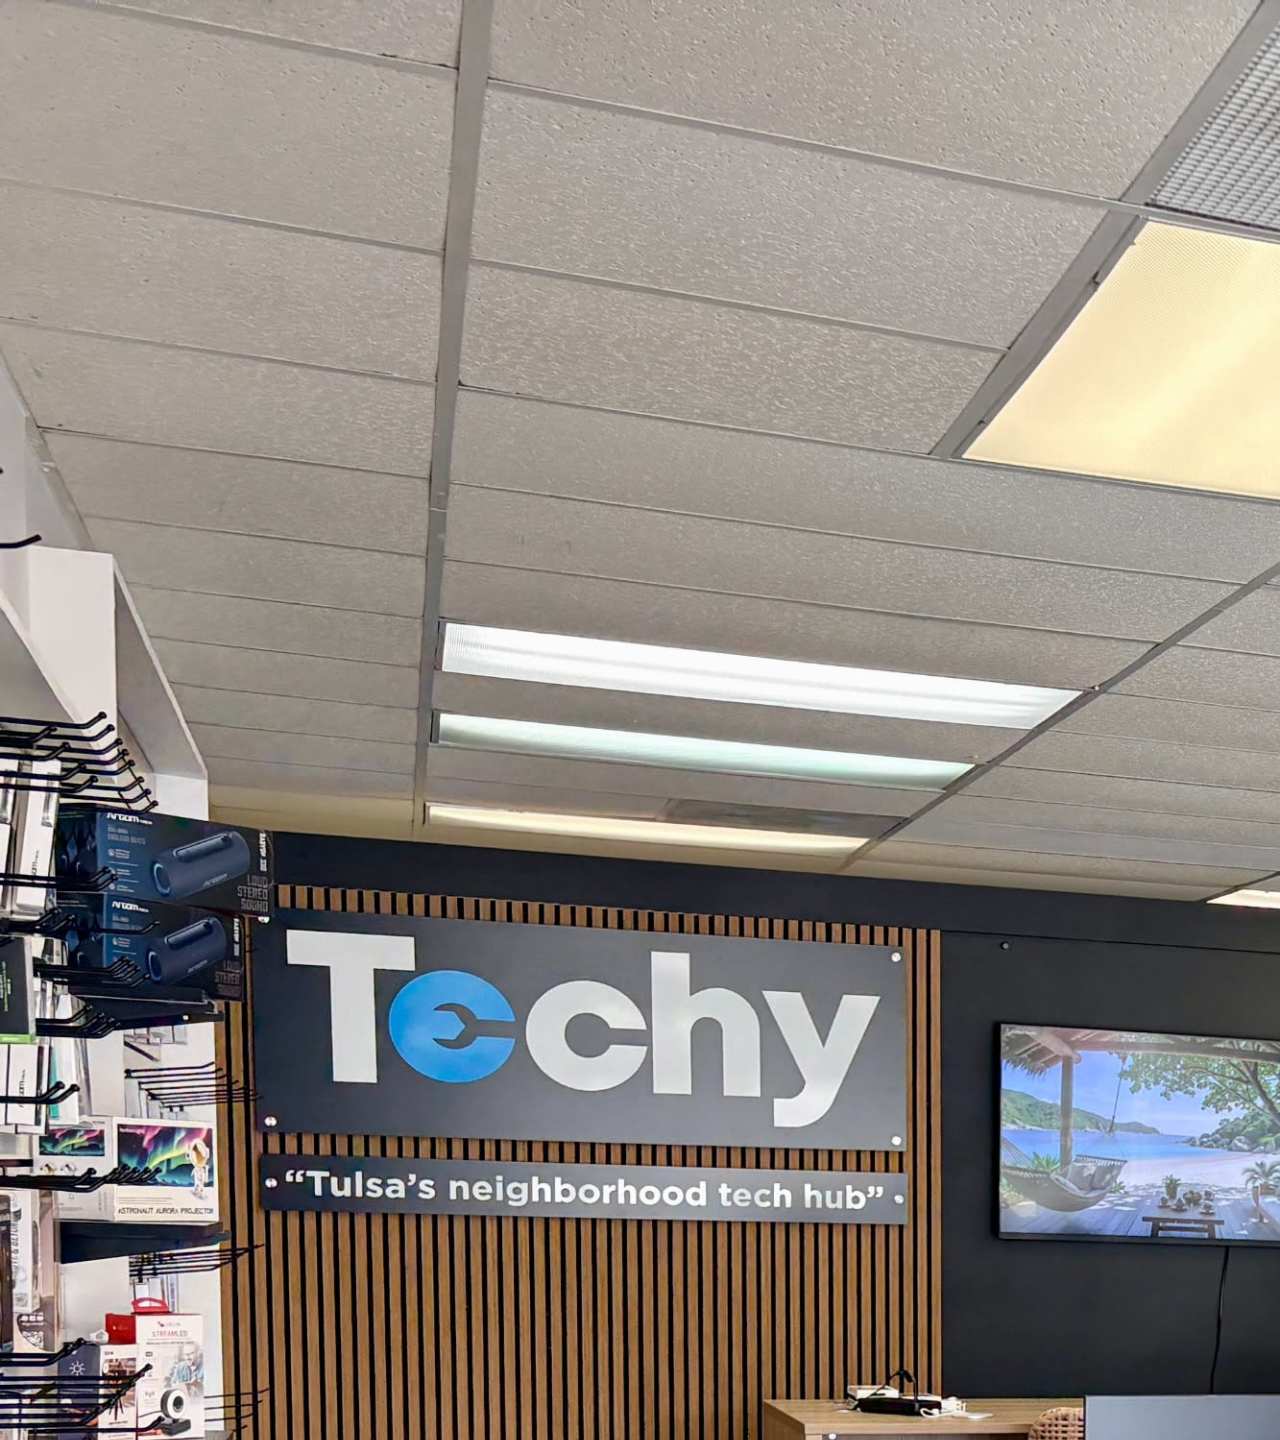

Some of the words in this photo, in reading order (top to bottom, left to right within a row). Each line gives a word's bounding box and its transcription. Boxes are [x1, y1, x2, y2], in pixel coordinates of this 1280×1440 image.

[237, 886, 268, 900] STEREO
[286, 929, 880, 1128] Techy
[449, 1178, 707, 1209] neighborhood
[719, 1182, 792, 1209] tech
[180, 1207, 214, 1215] PROJECTOR
